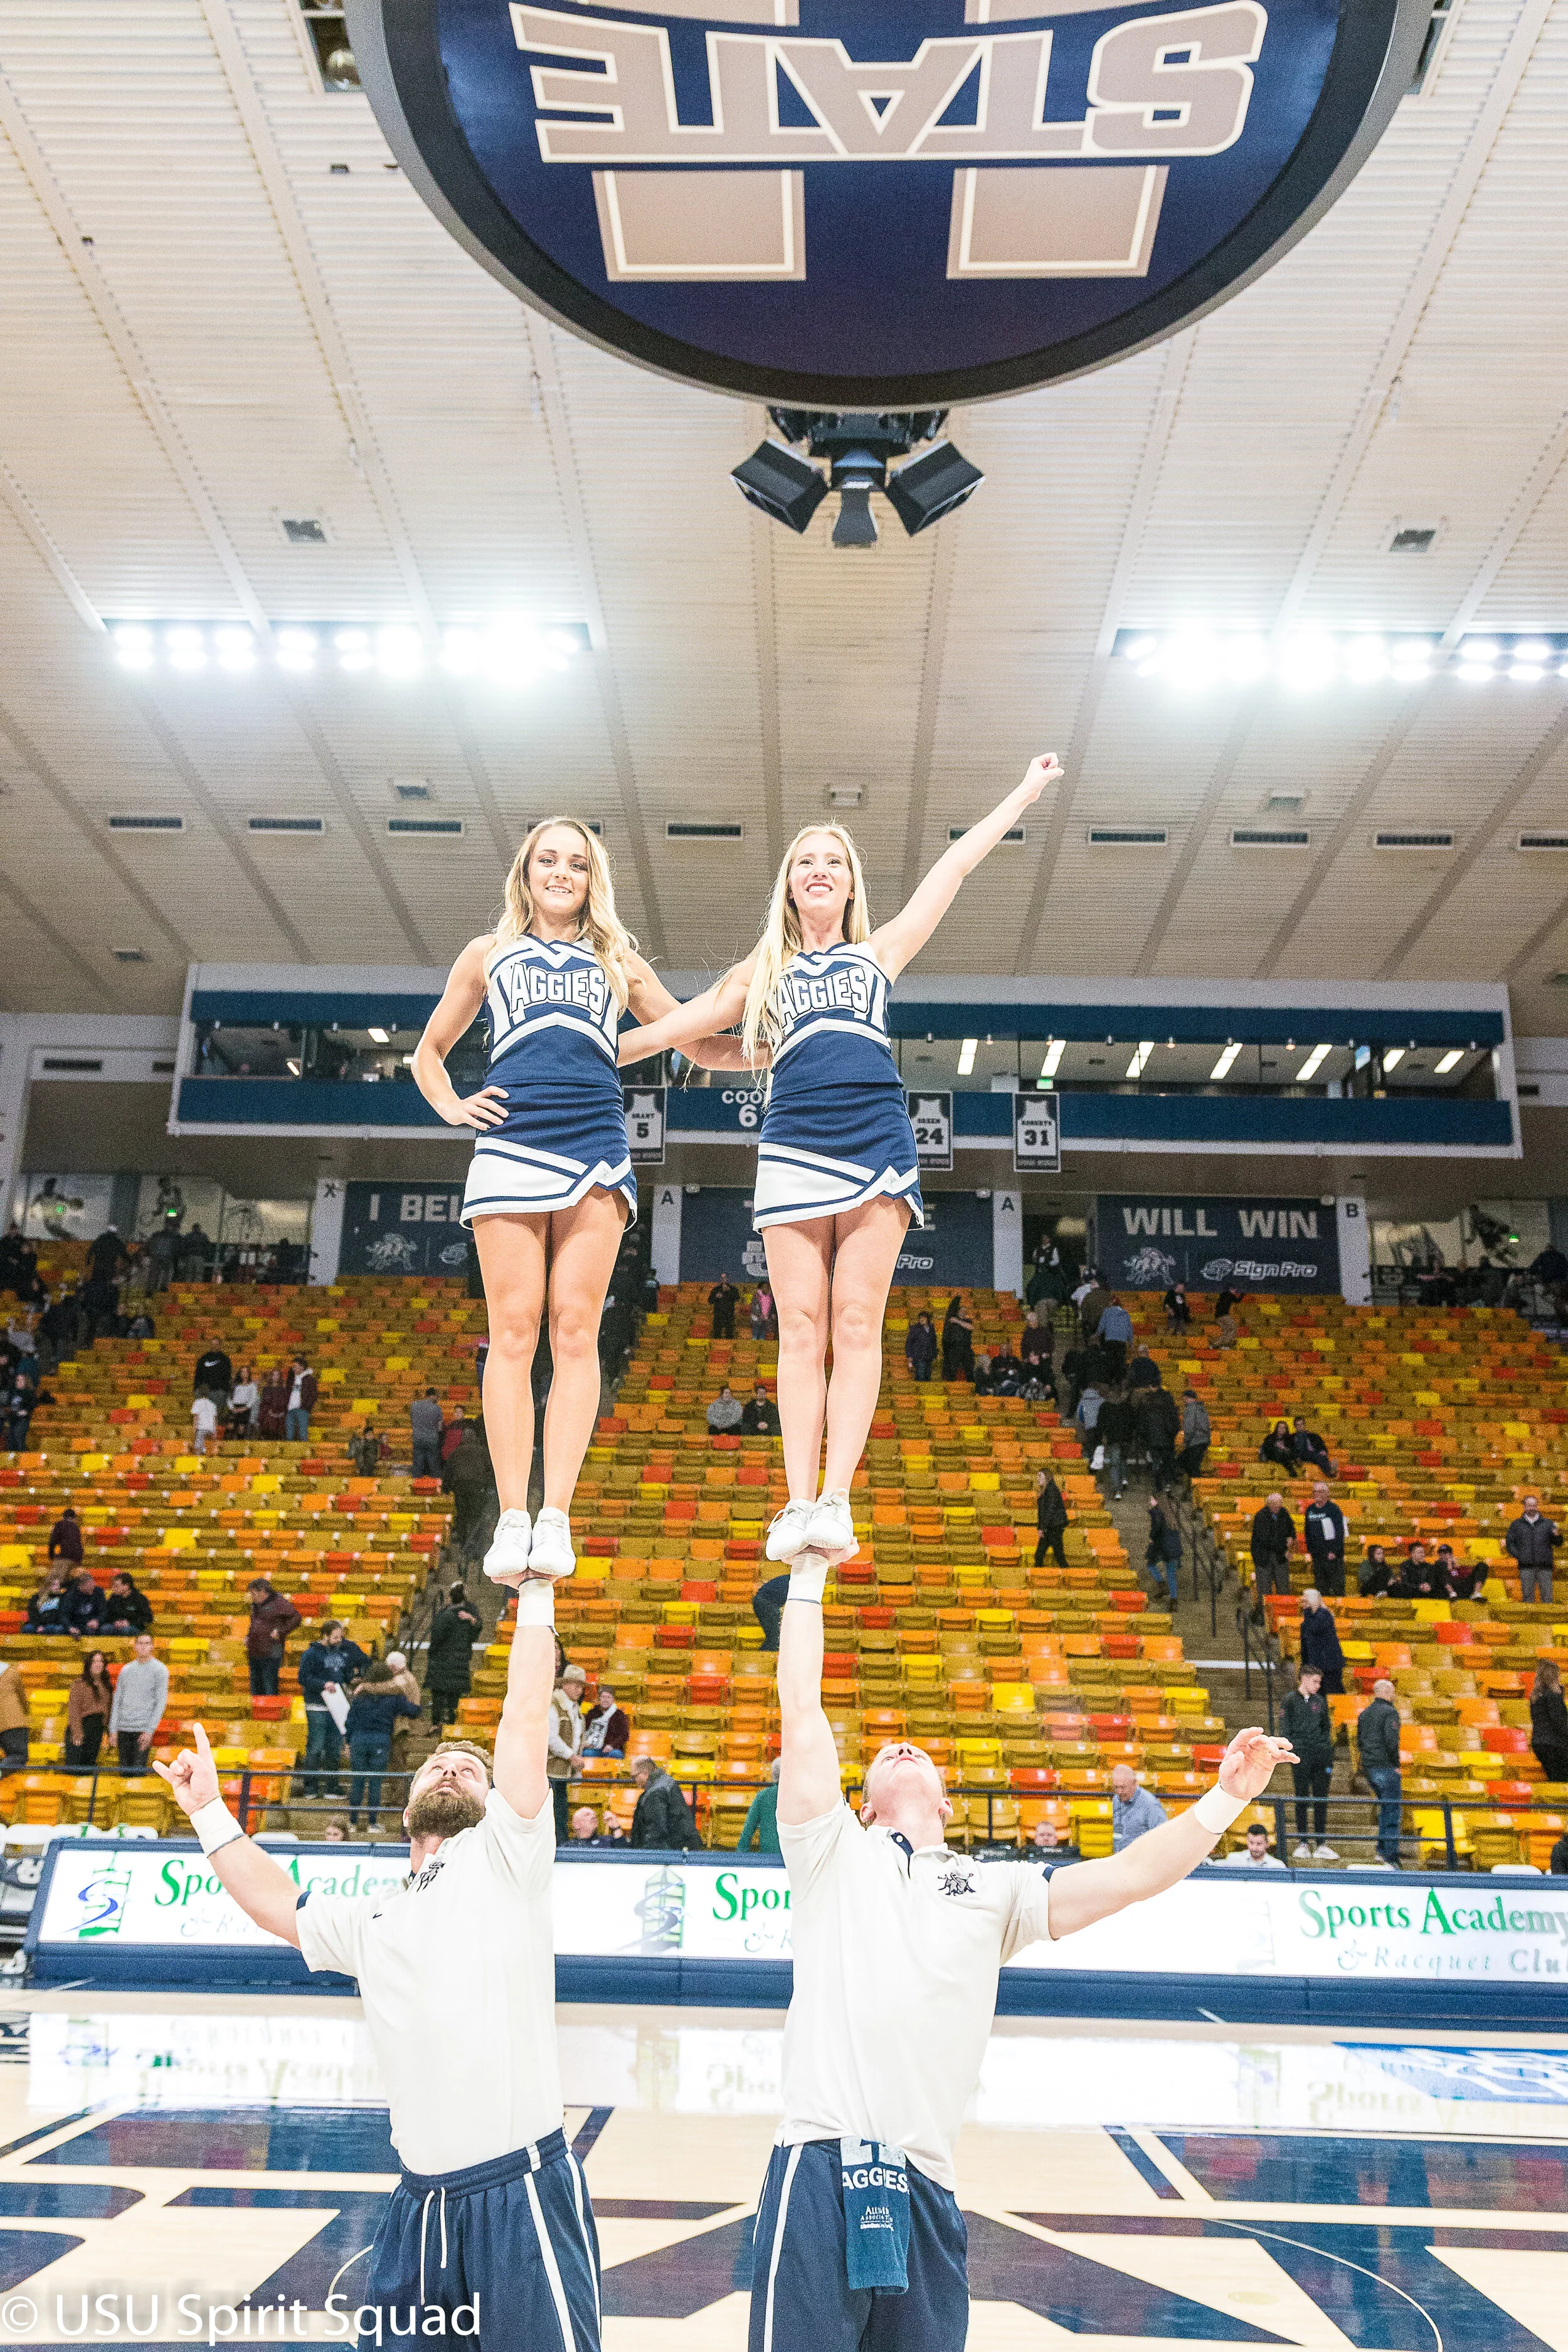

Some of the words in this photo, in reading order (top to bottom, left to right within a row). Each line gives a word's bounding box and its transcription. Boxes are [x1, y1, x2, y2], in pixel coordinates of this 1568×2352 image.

[509, 1, 1268, 163] STATE
[511, 962, 605, 1016] AGGIES
[778, 966, 869, 1027] AGGIES
[721, 1090, 766, 1104] COO
[738, 1103, 758, 1128] 6
[636, 1122, 649, 1138] 5
[915, 1127, 944, 1145] 24
[1024, 1129, 1050, 1147] 31
[324, 1183, 337, 1199] X
[660, 1189, 675, 1205] A
[369, 1193, 380, 1221] I
[1002, 1196, 1015, 1212] A
[1346, 1203, 1359, 1218] B
[1123, 1207, 1218, 1237] WILL
[1238, 1209, 1318, 1239] WIN
[895, 1254, 934, 1270] Pro
[154, 1859, 227, 1907] Spo
[712, 1873, 792, 1921] Spor
[1298, 1889, 1411, 1939] Sports
[1419, 1886, 1568, 1947] Academy
[1374, 1946, 1491, 1978] Racquet
[1508, 1949, 1568, 1976] Clu
